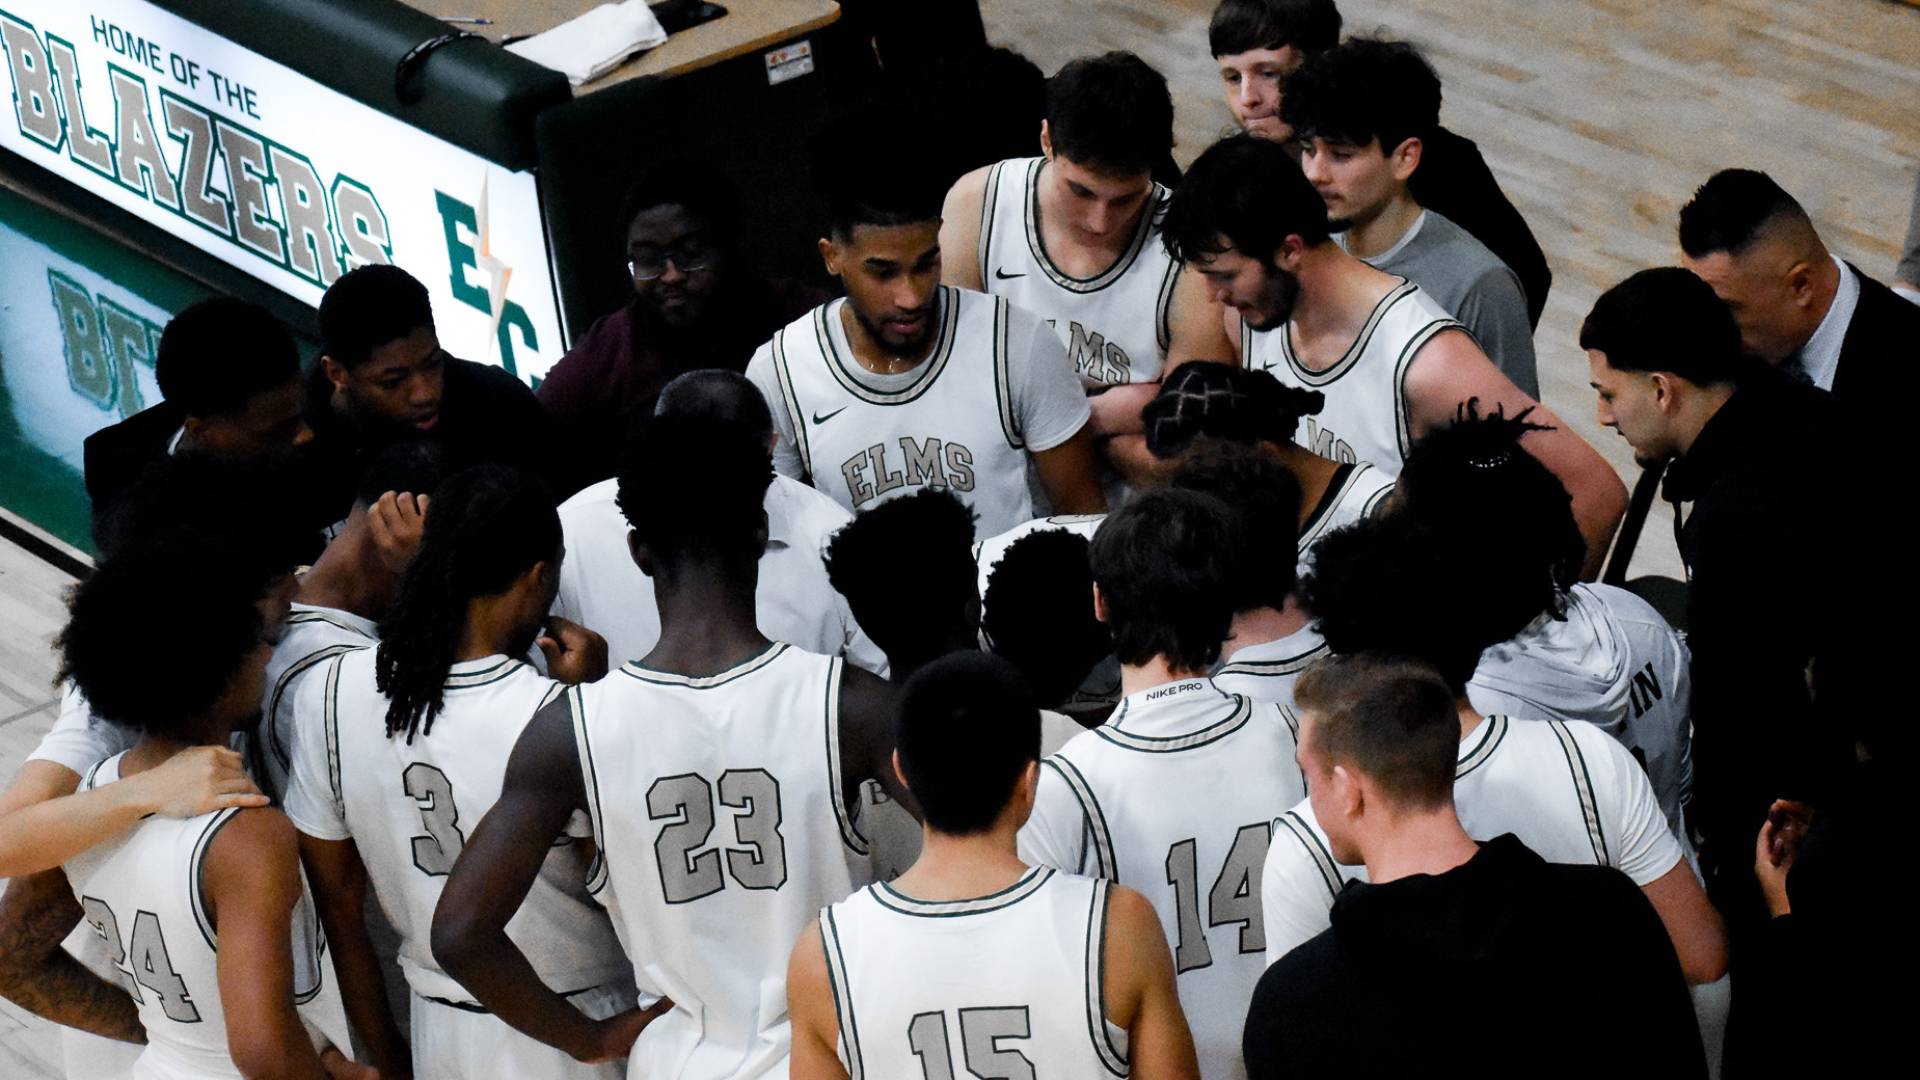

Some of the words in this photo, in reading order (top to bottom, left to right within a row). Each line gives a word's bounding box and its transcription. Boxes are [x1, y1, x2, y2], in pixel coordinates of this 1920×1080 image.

[91, 14, 164, 74] HOME
[169, 52, 201, 90] OF
[207, 69, 261, 120] THE
[0, 9, 394, 292] BLAZERS
[1046, 319, 1131, 386] MS
[841, 436, 976, 508] ELMS
[1146, 686, 1177, 701] NIKE
[1178, 682, 1203, 693] PRO
[1629, 661, 1663, 719] IN
[402, 762, 465, 877] 3
[646, 767, 788, 905] 23
[1165, 821, 1272, 975] 14
[82, 895, 203, 1024] 24
[908, 1005, 1037, 1080] 15
